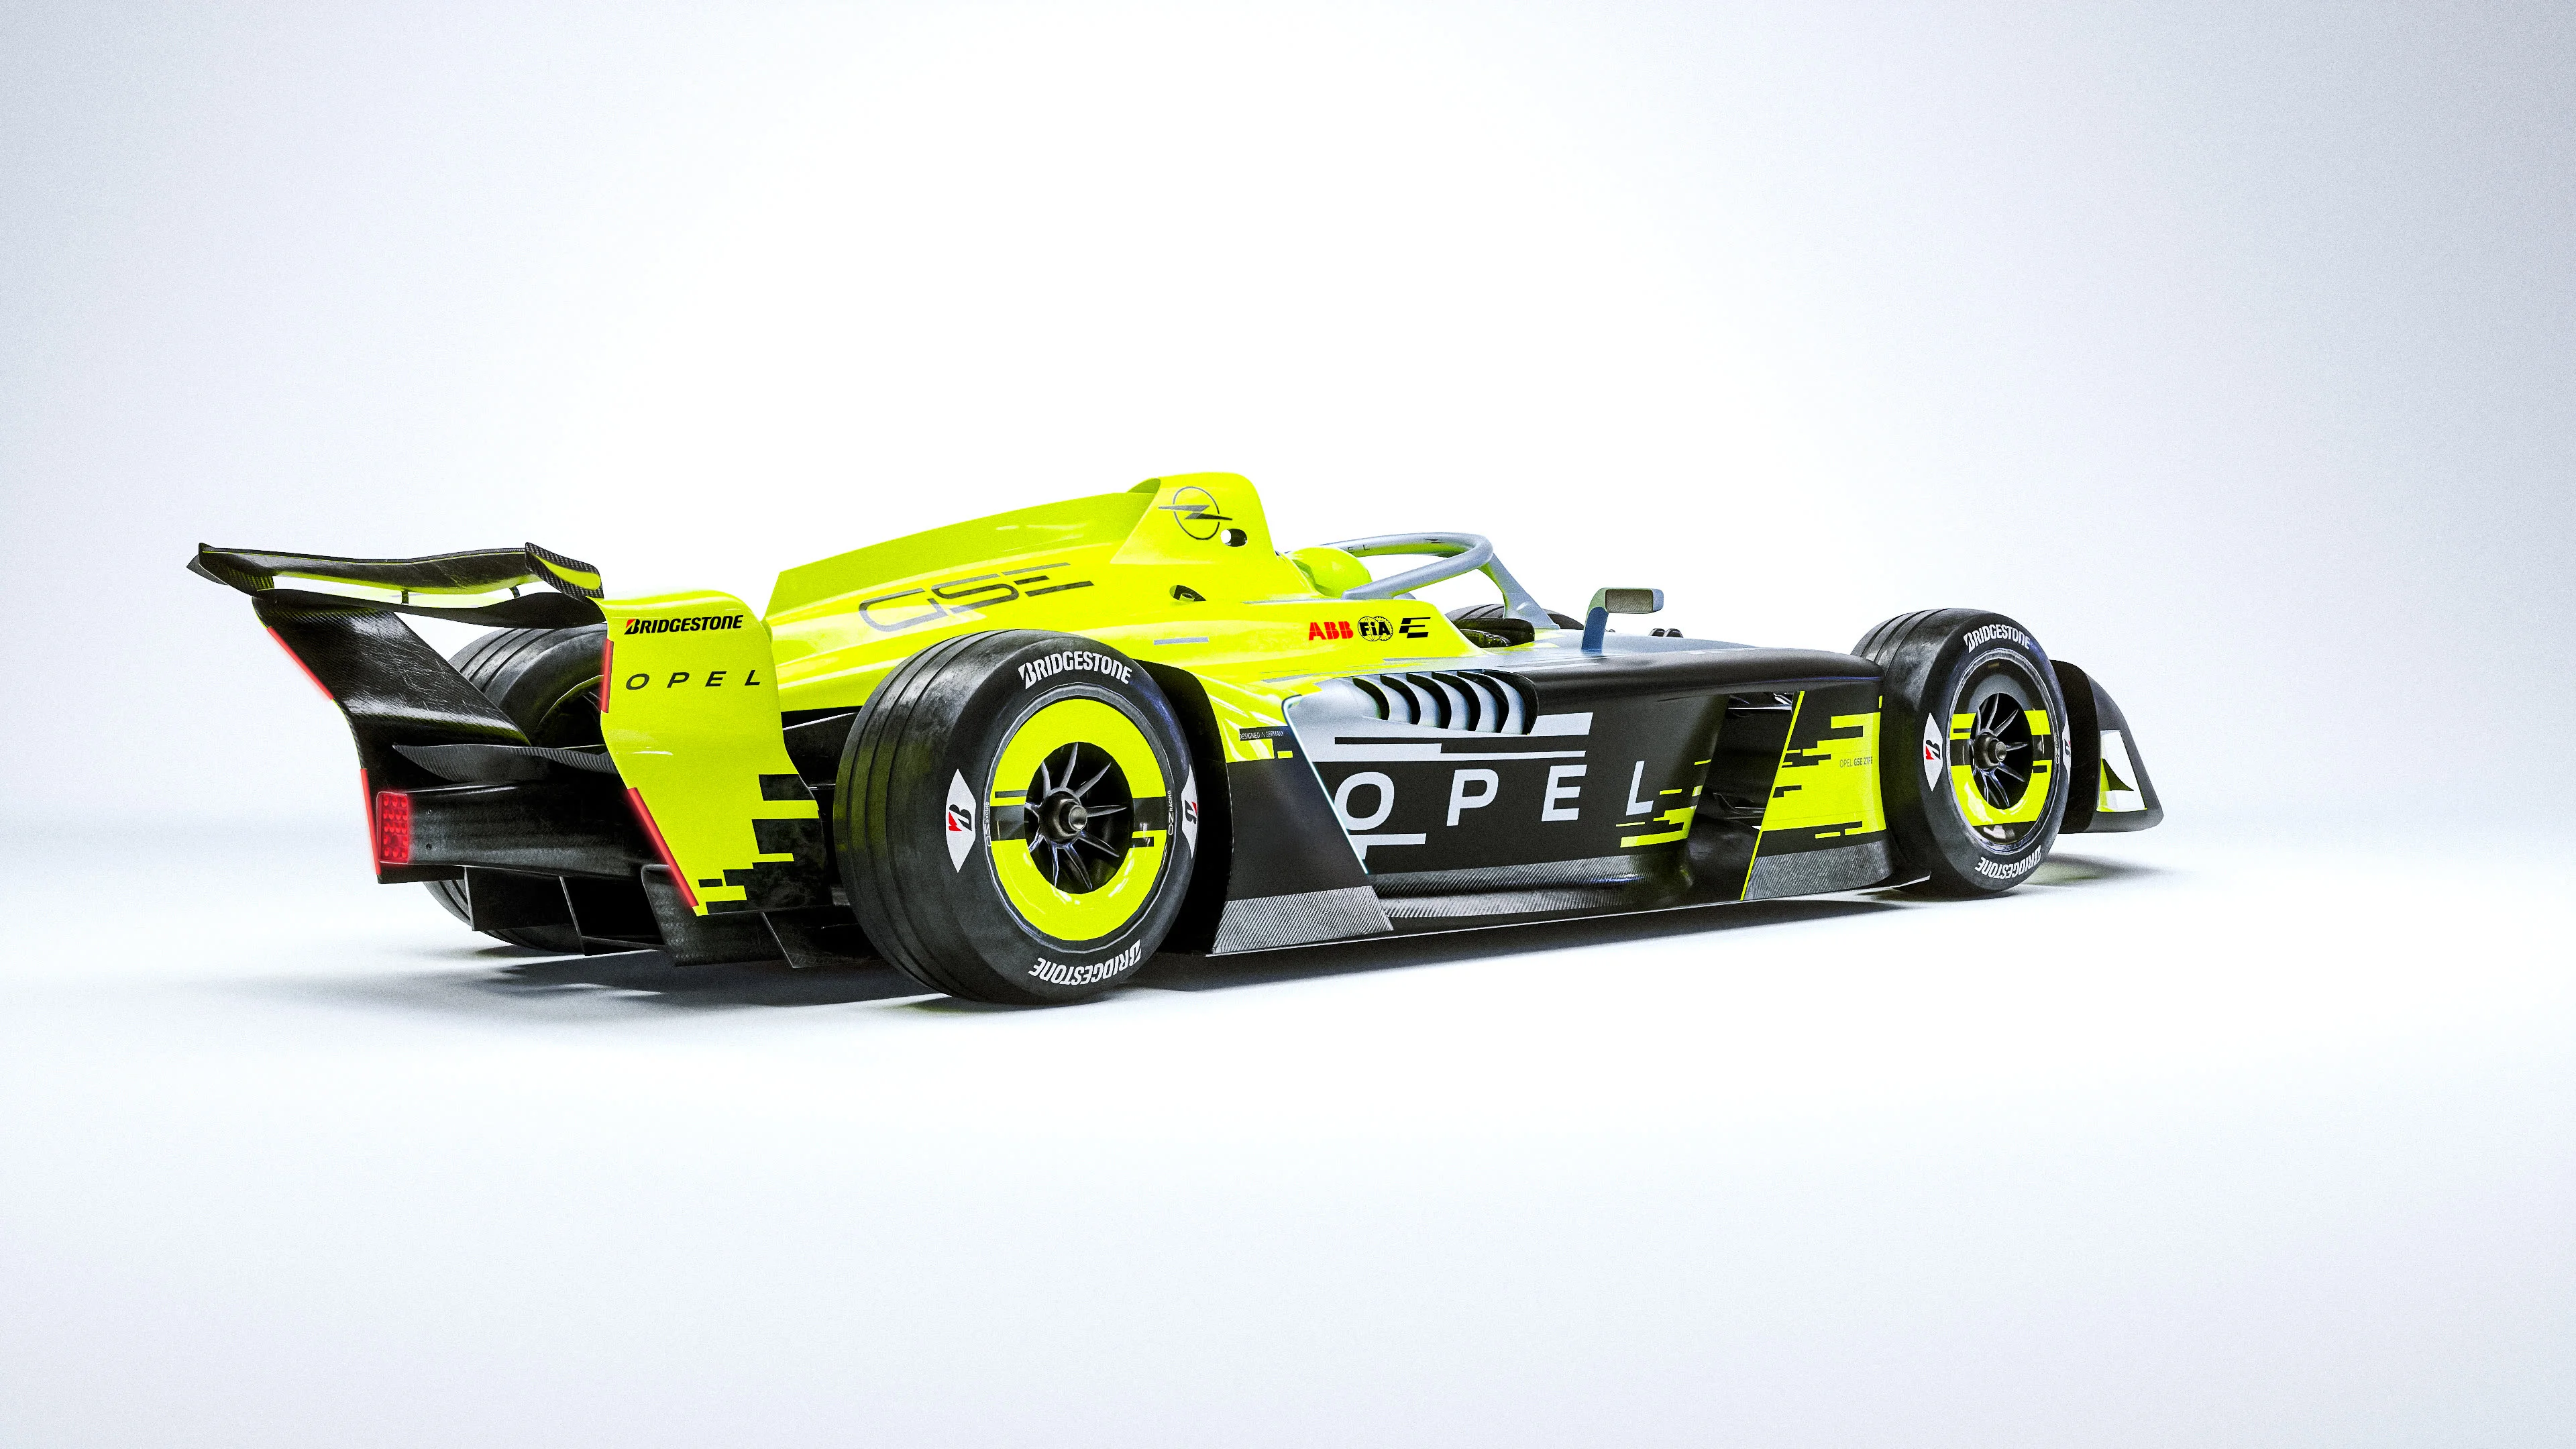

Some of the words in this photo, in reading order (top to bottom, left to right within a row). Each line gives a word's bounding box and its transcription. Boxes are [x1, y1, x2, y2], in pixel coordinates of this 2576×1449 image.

[859, 562, 1094, 632] GSE
[624, 614, 744, 635] BRIDGESTONE
[1309, 621, 1354, 641] ABB
[1963, 624, 2031, 653] BRIDGESTONE
[625, 669, 761, 690] OPEL
[1018, 651, 1132, 690] BRIDGESTONE
[1240, 732, 1260, 740] DESIGNED
[1839, 759, 1853, 768] OPEL
[1334, 760, 1654, 830] OPEL
[1974, 845, 2041, 879] BRIDGESTONE
[1028, 939, 1142, 985] BRIDGESTONE
